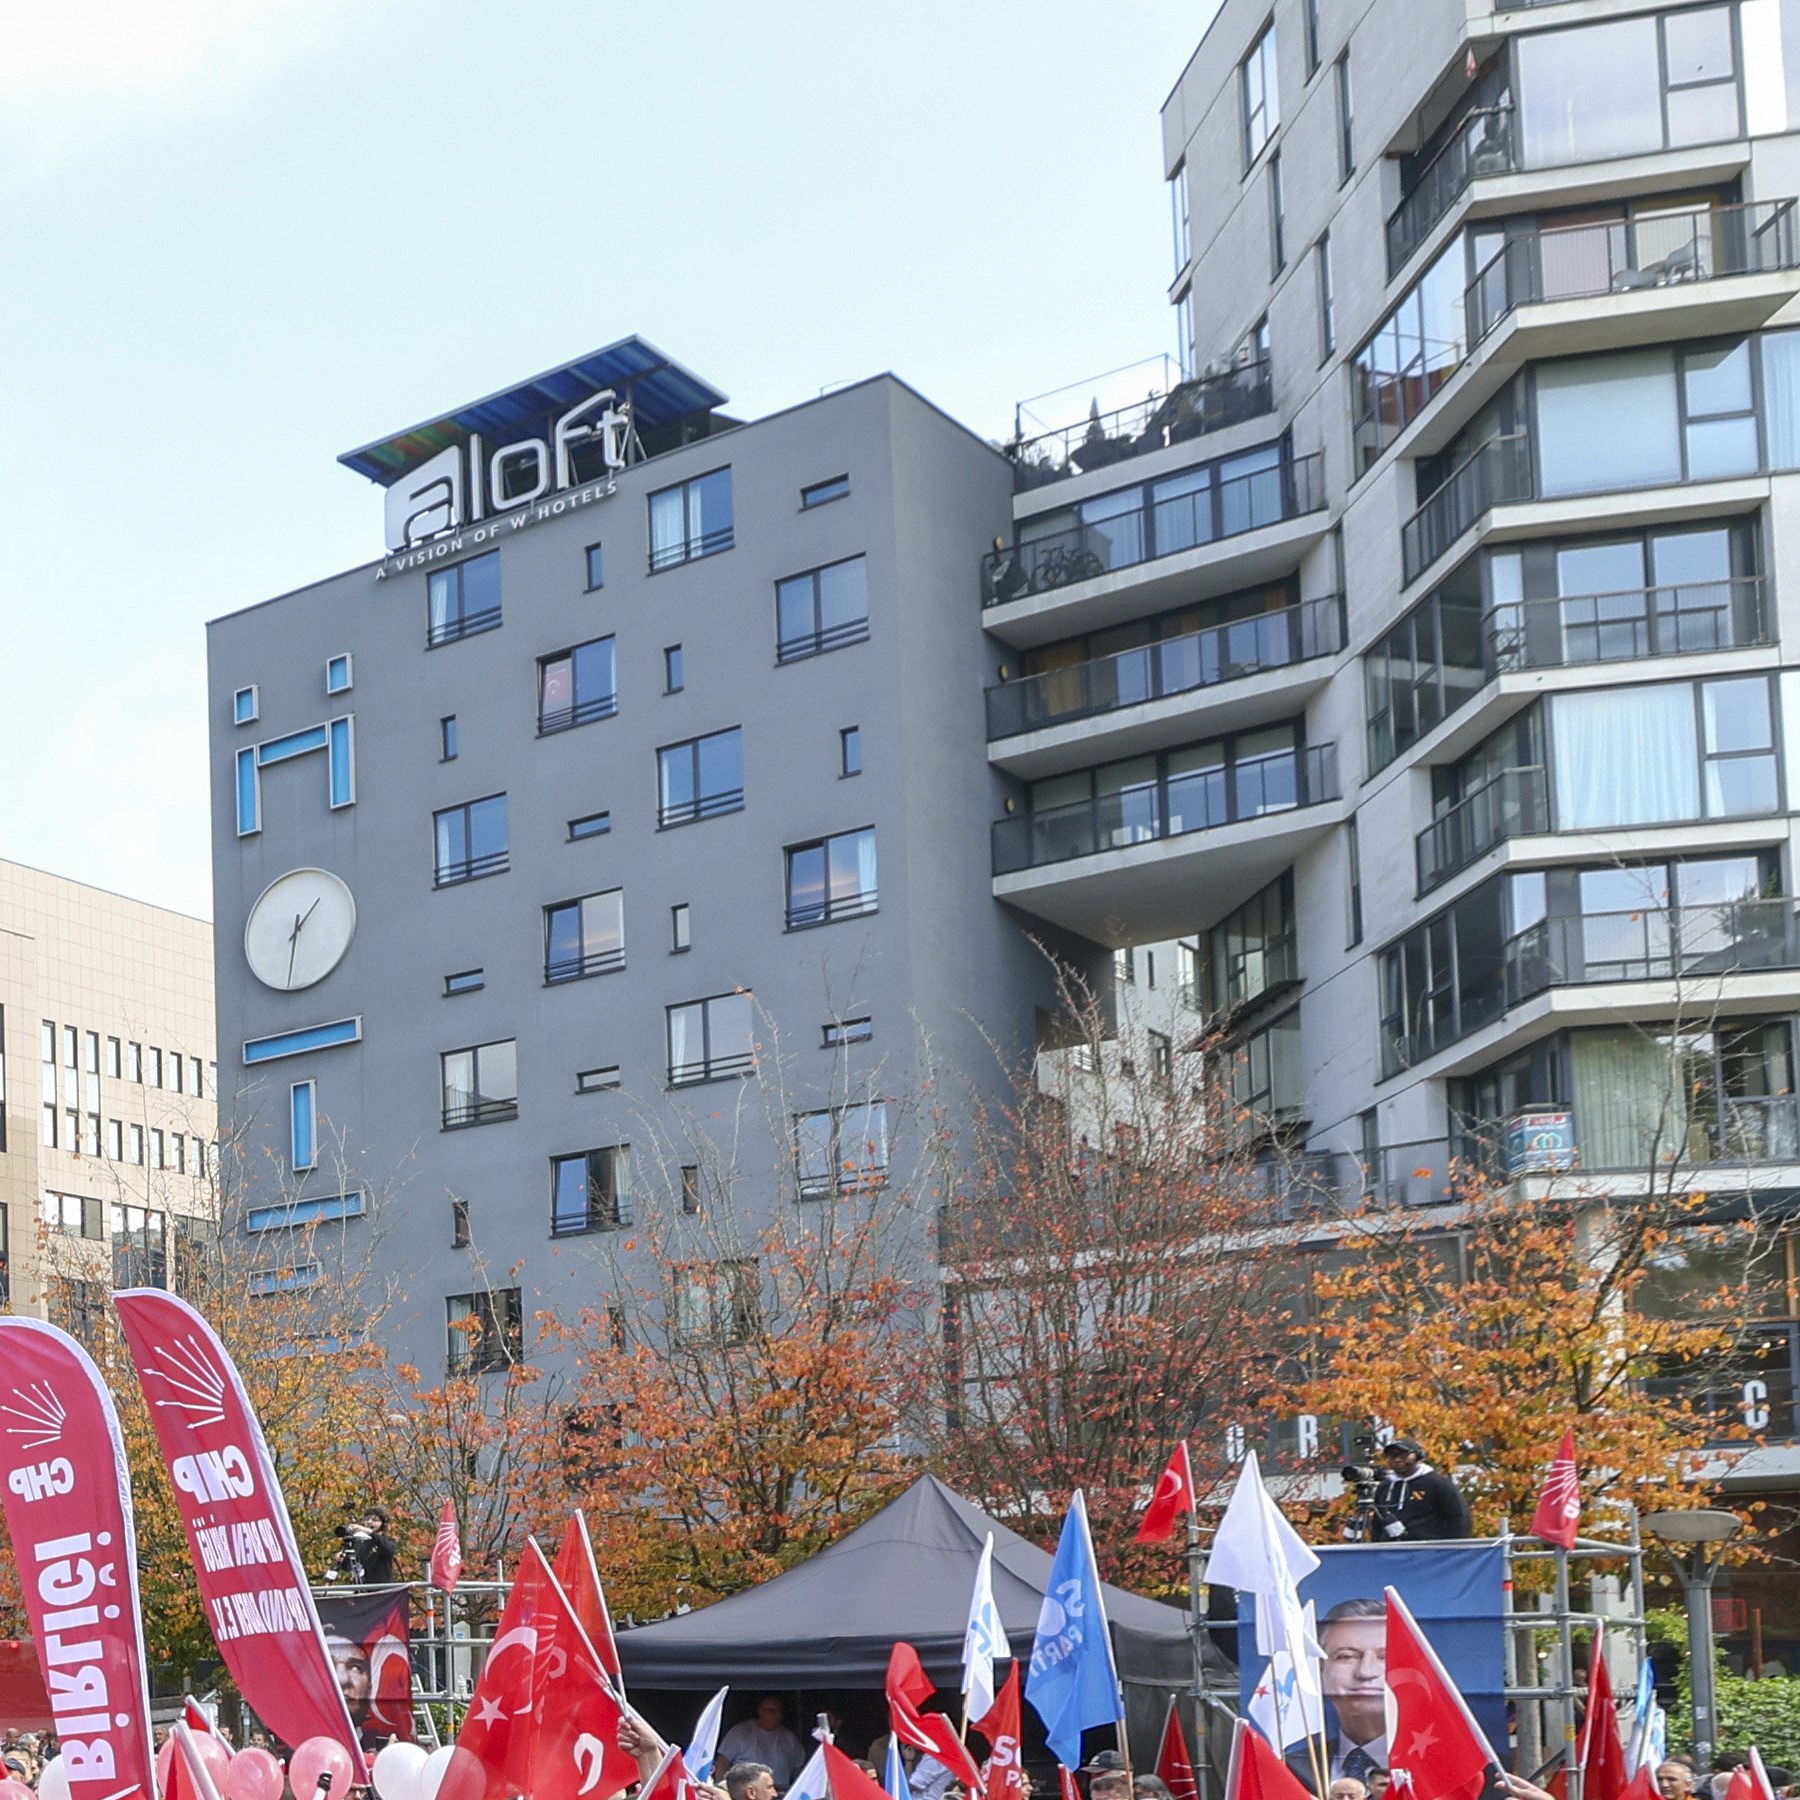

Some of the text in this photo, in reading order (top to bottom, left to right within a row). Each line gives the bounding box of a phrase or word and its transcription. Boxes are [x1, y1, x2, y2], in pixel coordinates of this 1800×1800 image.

[375, 480, 618, 580] A VISION OF W HOTELS
[384, 389, 629, 552] aloft
